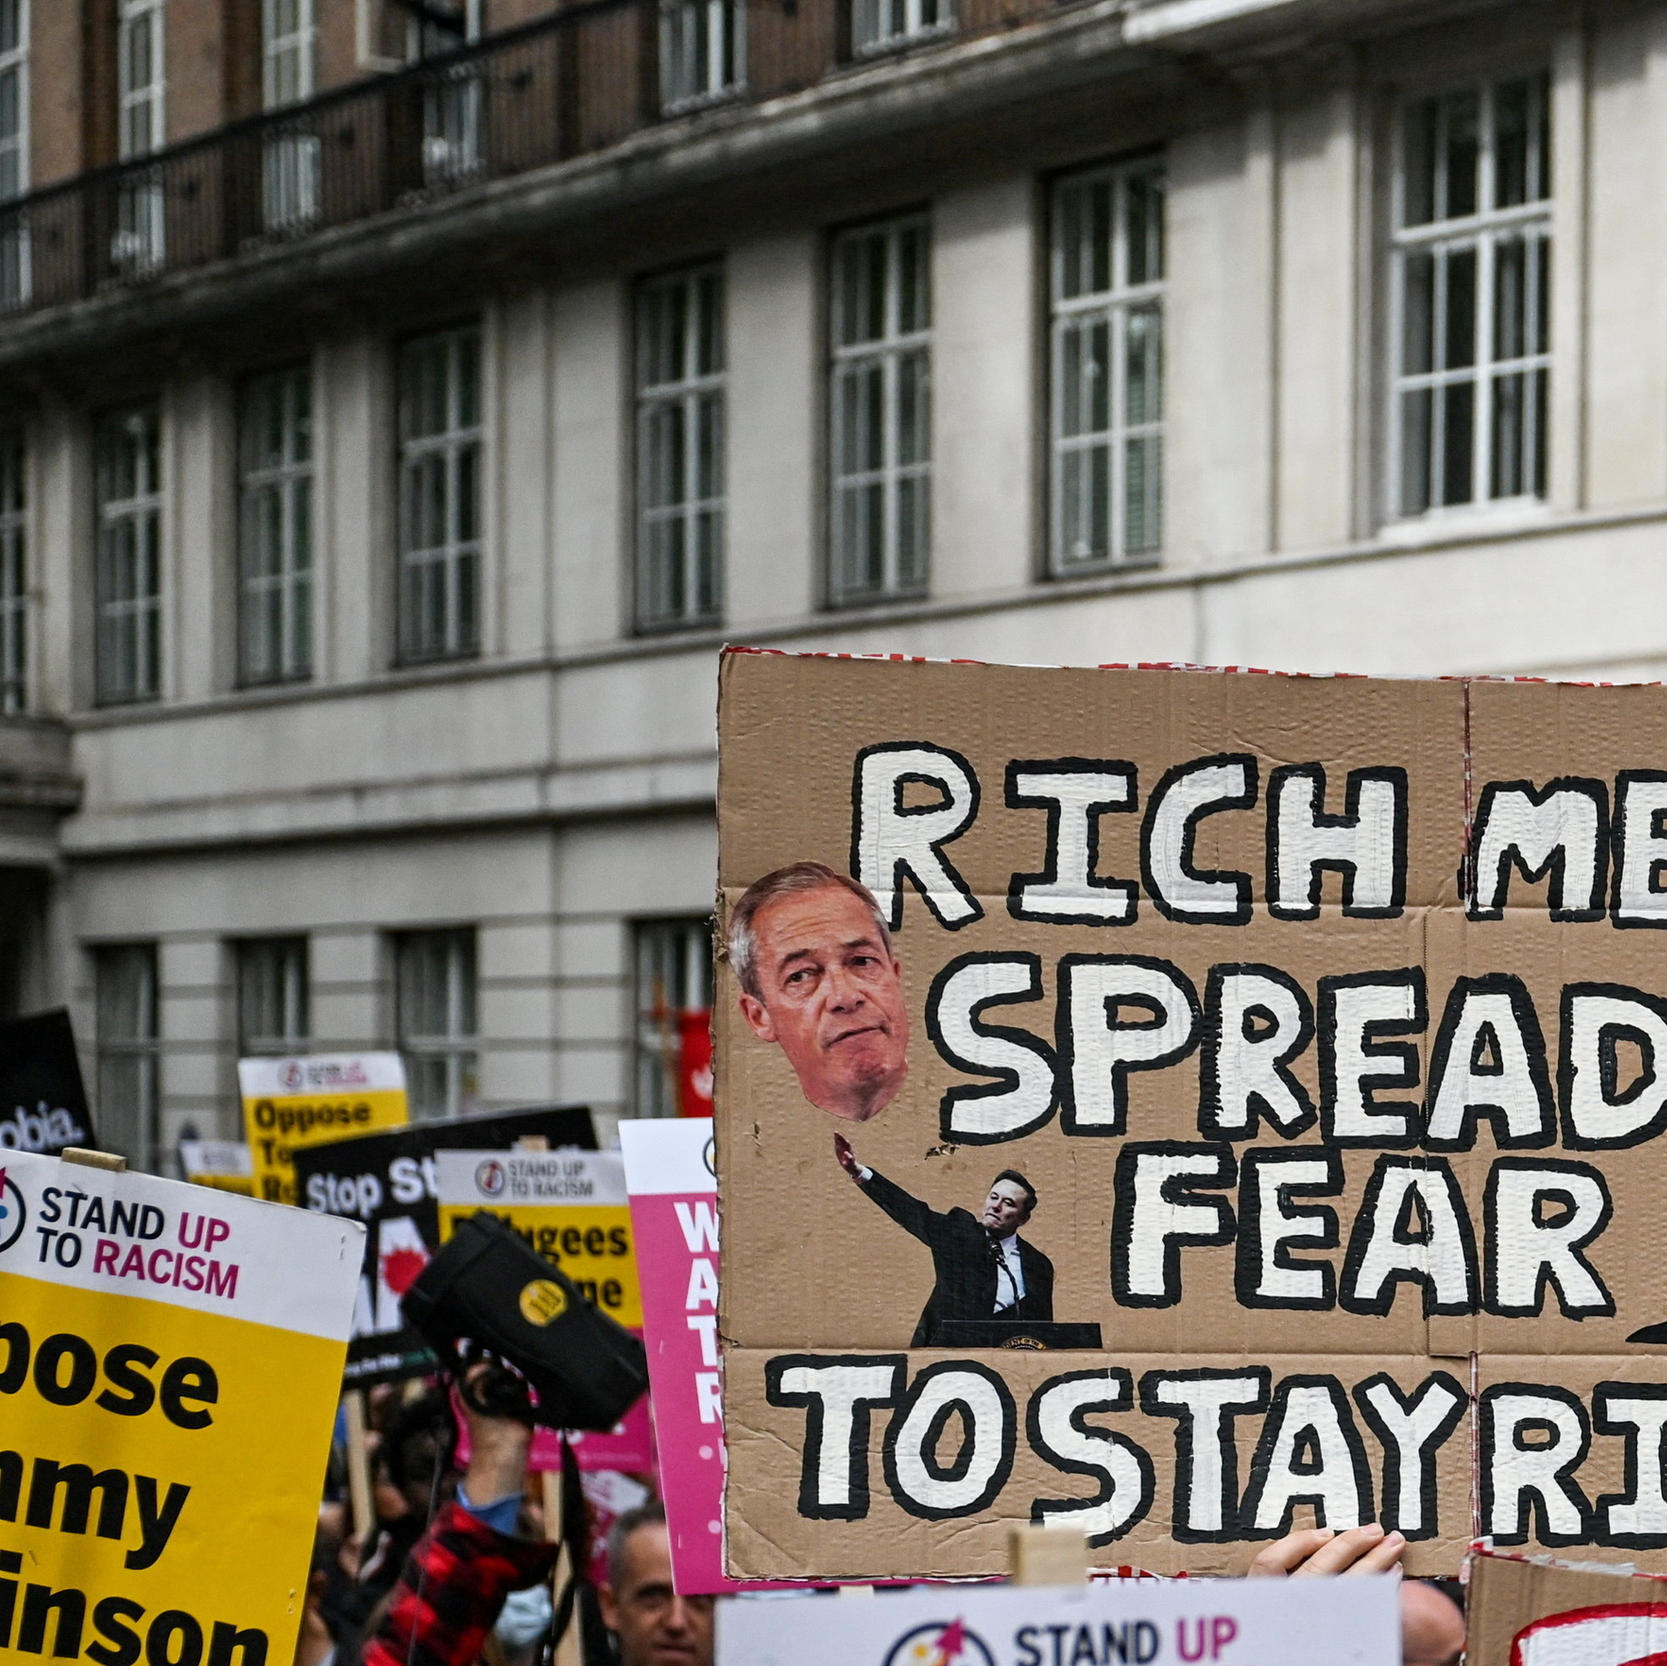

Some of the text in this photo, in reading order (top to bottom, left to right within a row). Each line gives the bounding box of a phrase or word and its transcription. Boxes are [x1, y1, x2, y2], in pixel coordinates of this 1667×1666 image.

[850, 740, 1409, 930] RICH
[254, 1100, 371, 1134] Oppose
[507, 1159, 585, 1179] STAND UP
[508, 1178, 593, 1198] TO RACISM
[305, 1171, 382, 1218] Stop
[39, 1187, 230, 1253] STAND UP
[1111, 1142, 1615, 1319] FEAR
[36, 1226, 239, 1299] TO RACISM
[1177, 1616, 1240, 1663] UP
